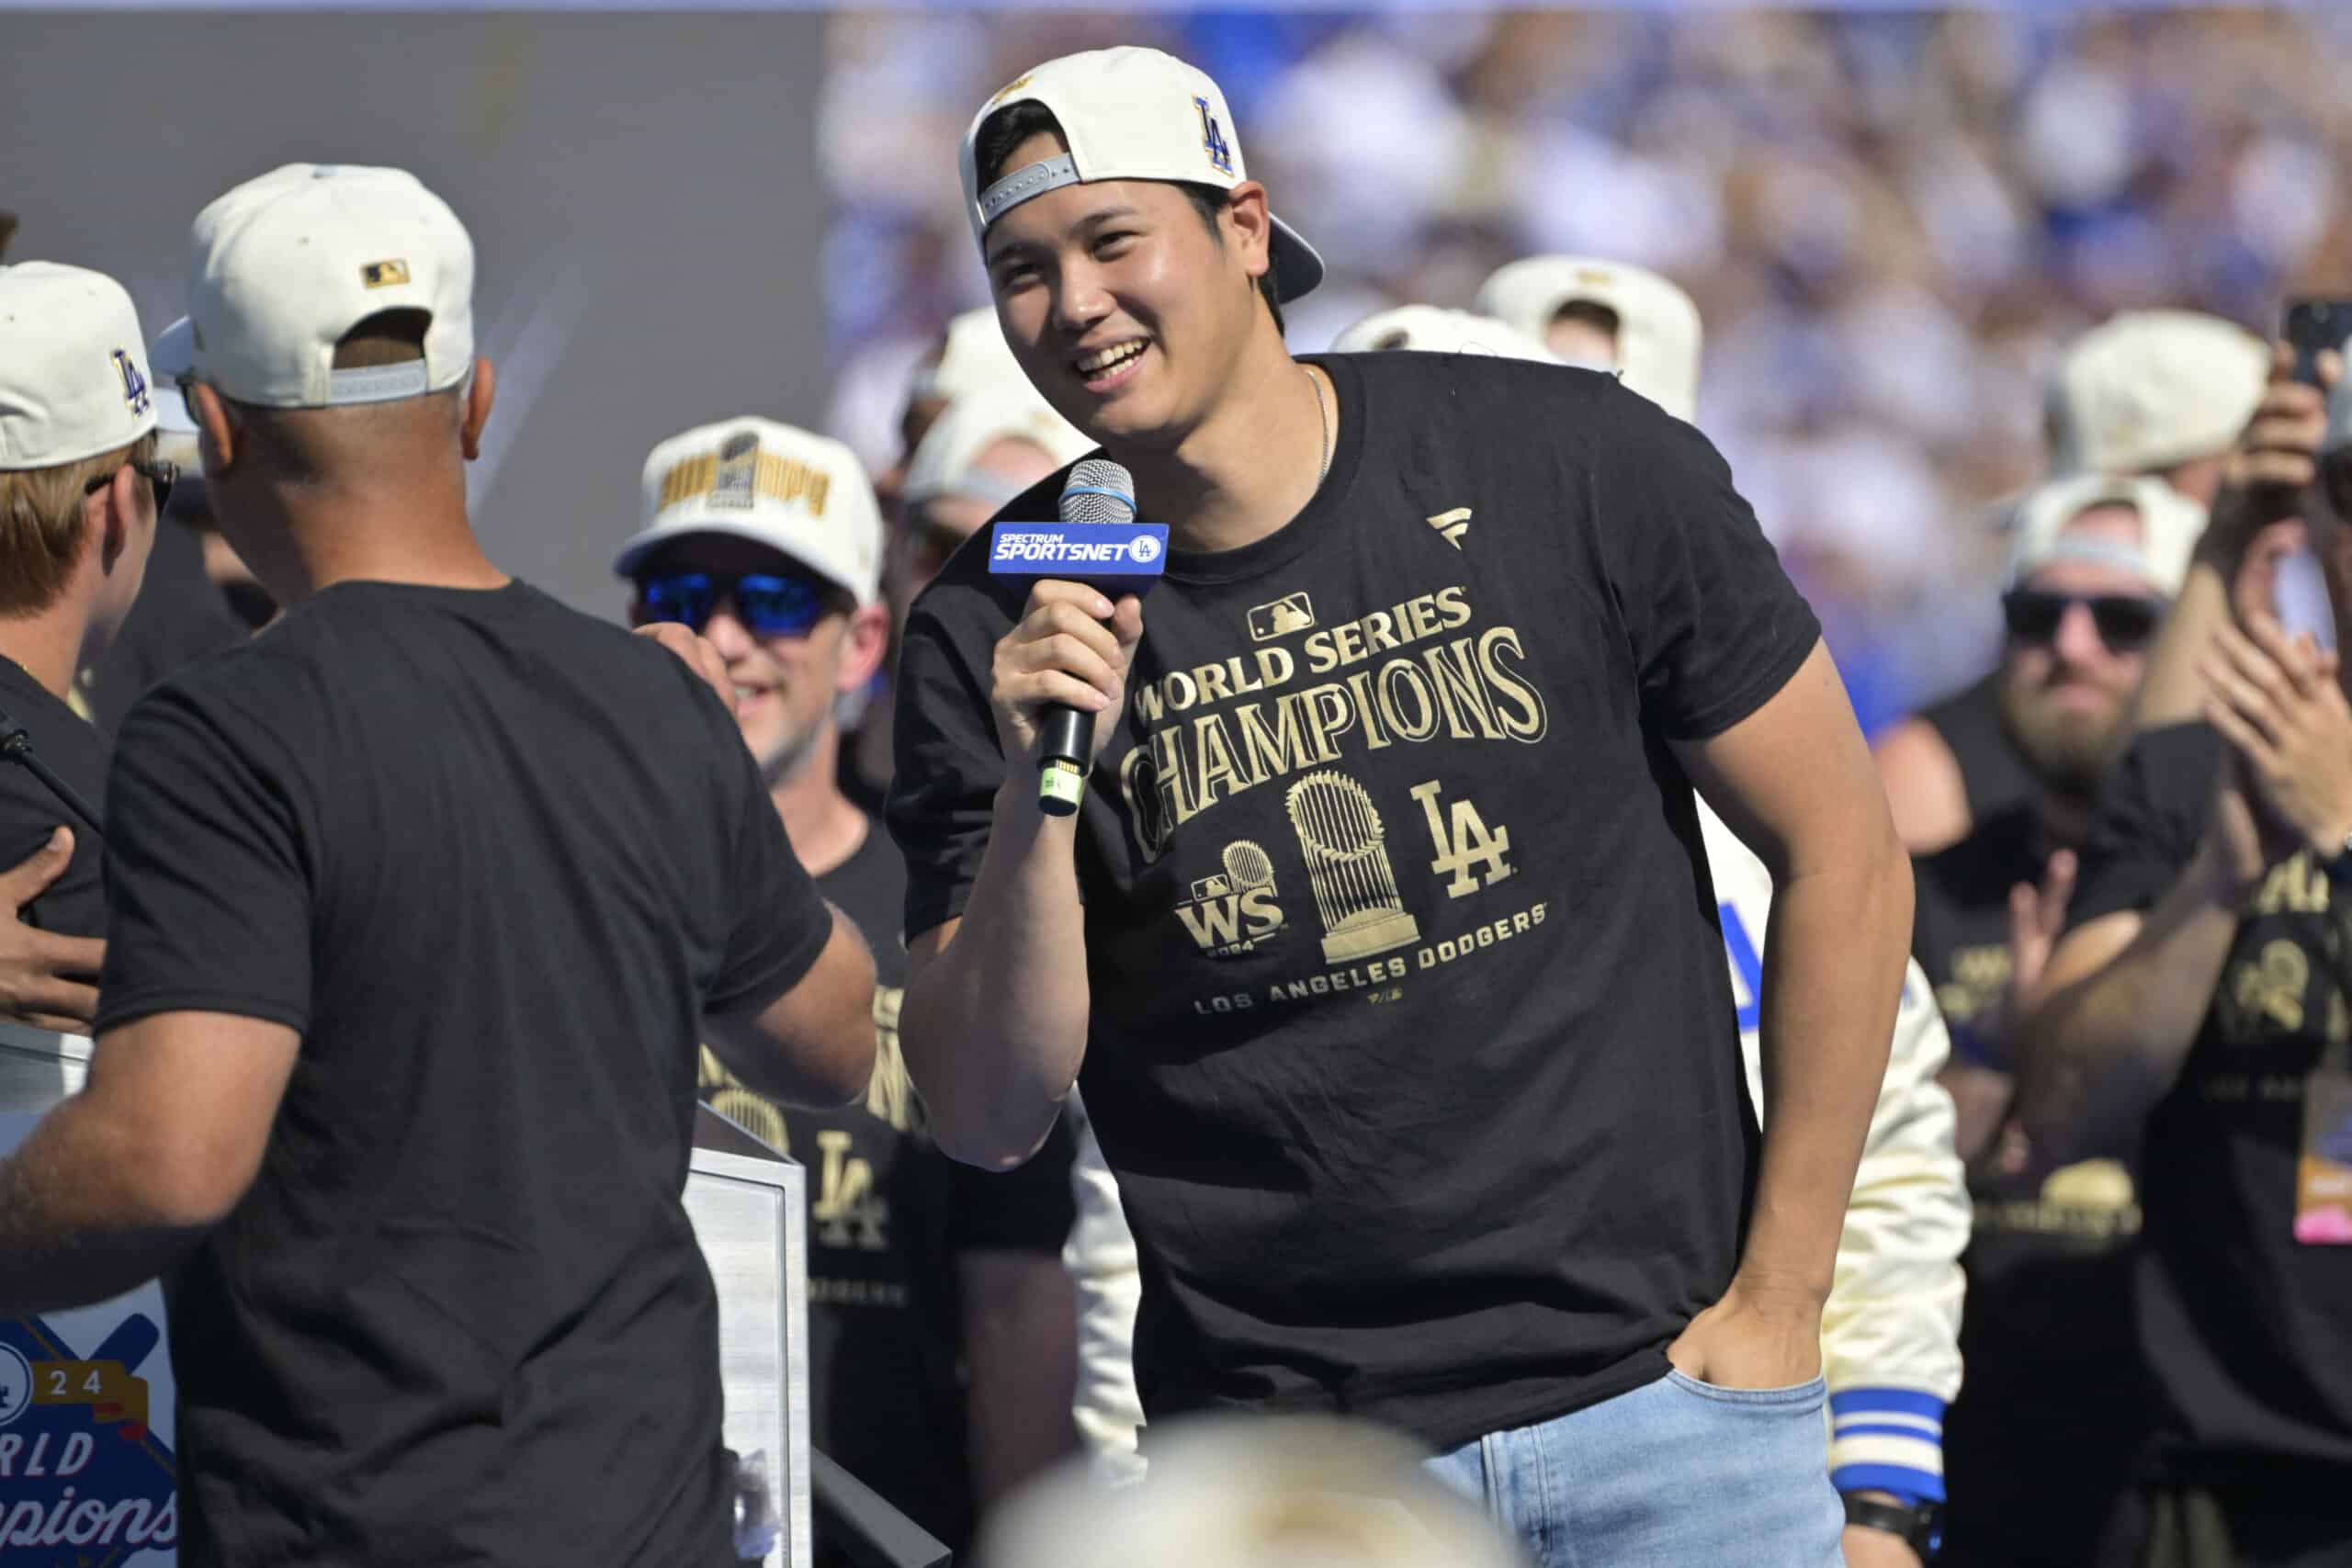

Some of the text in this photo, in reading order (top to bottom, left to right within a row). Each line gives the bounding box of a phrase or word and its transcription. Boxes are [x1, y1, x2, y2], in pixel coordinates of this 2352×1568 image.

[994, 543, 1129, 561] SPORTSNET
[1000, 534, 1064, 543] SPECTRUM
[1134, 586, 1472, 727] WORLD SERIES
[1119, 626, 1548, 864] CHAMPIONS
[1410, 780, 1511, 899] LA
[1174, 886, 1284, 949] WS
[1195, 904, 1545, 1015] LOS ANGELES DODGERS
